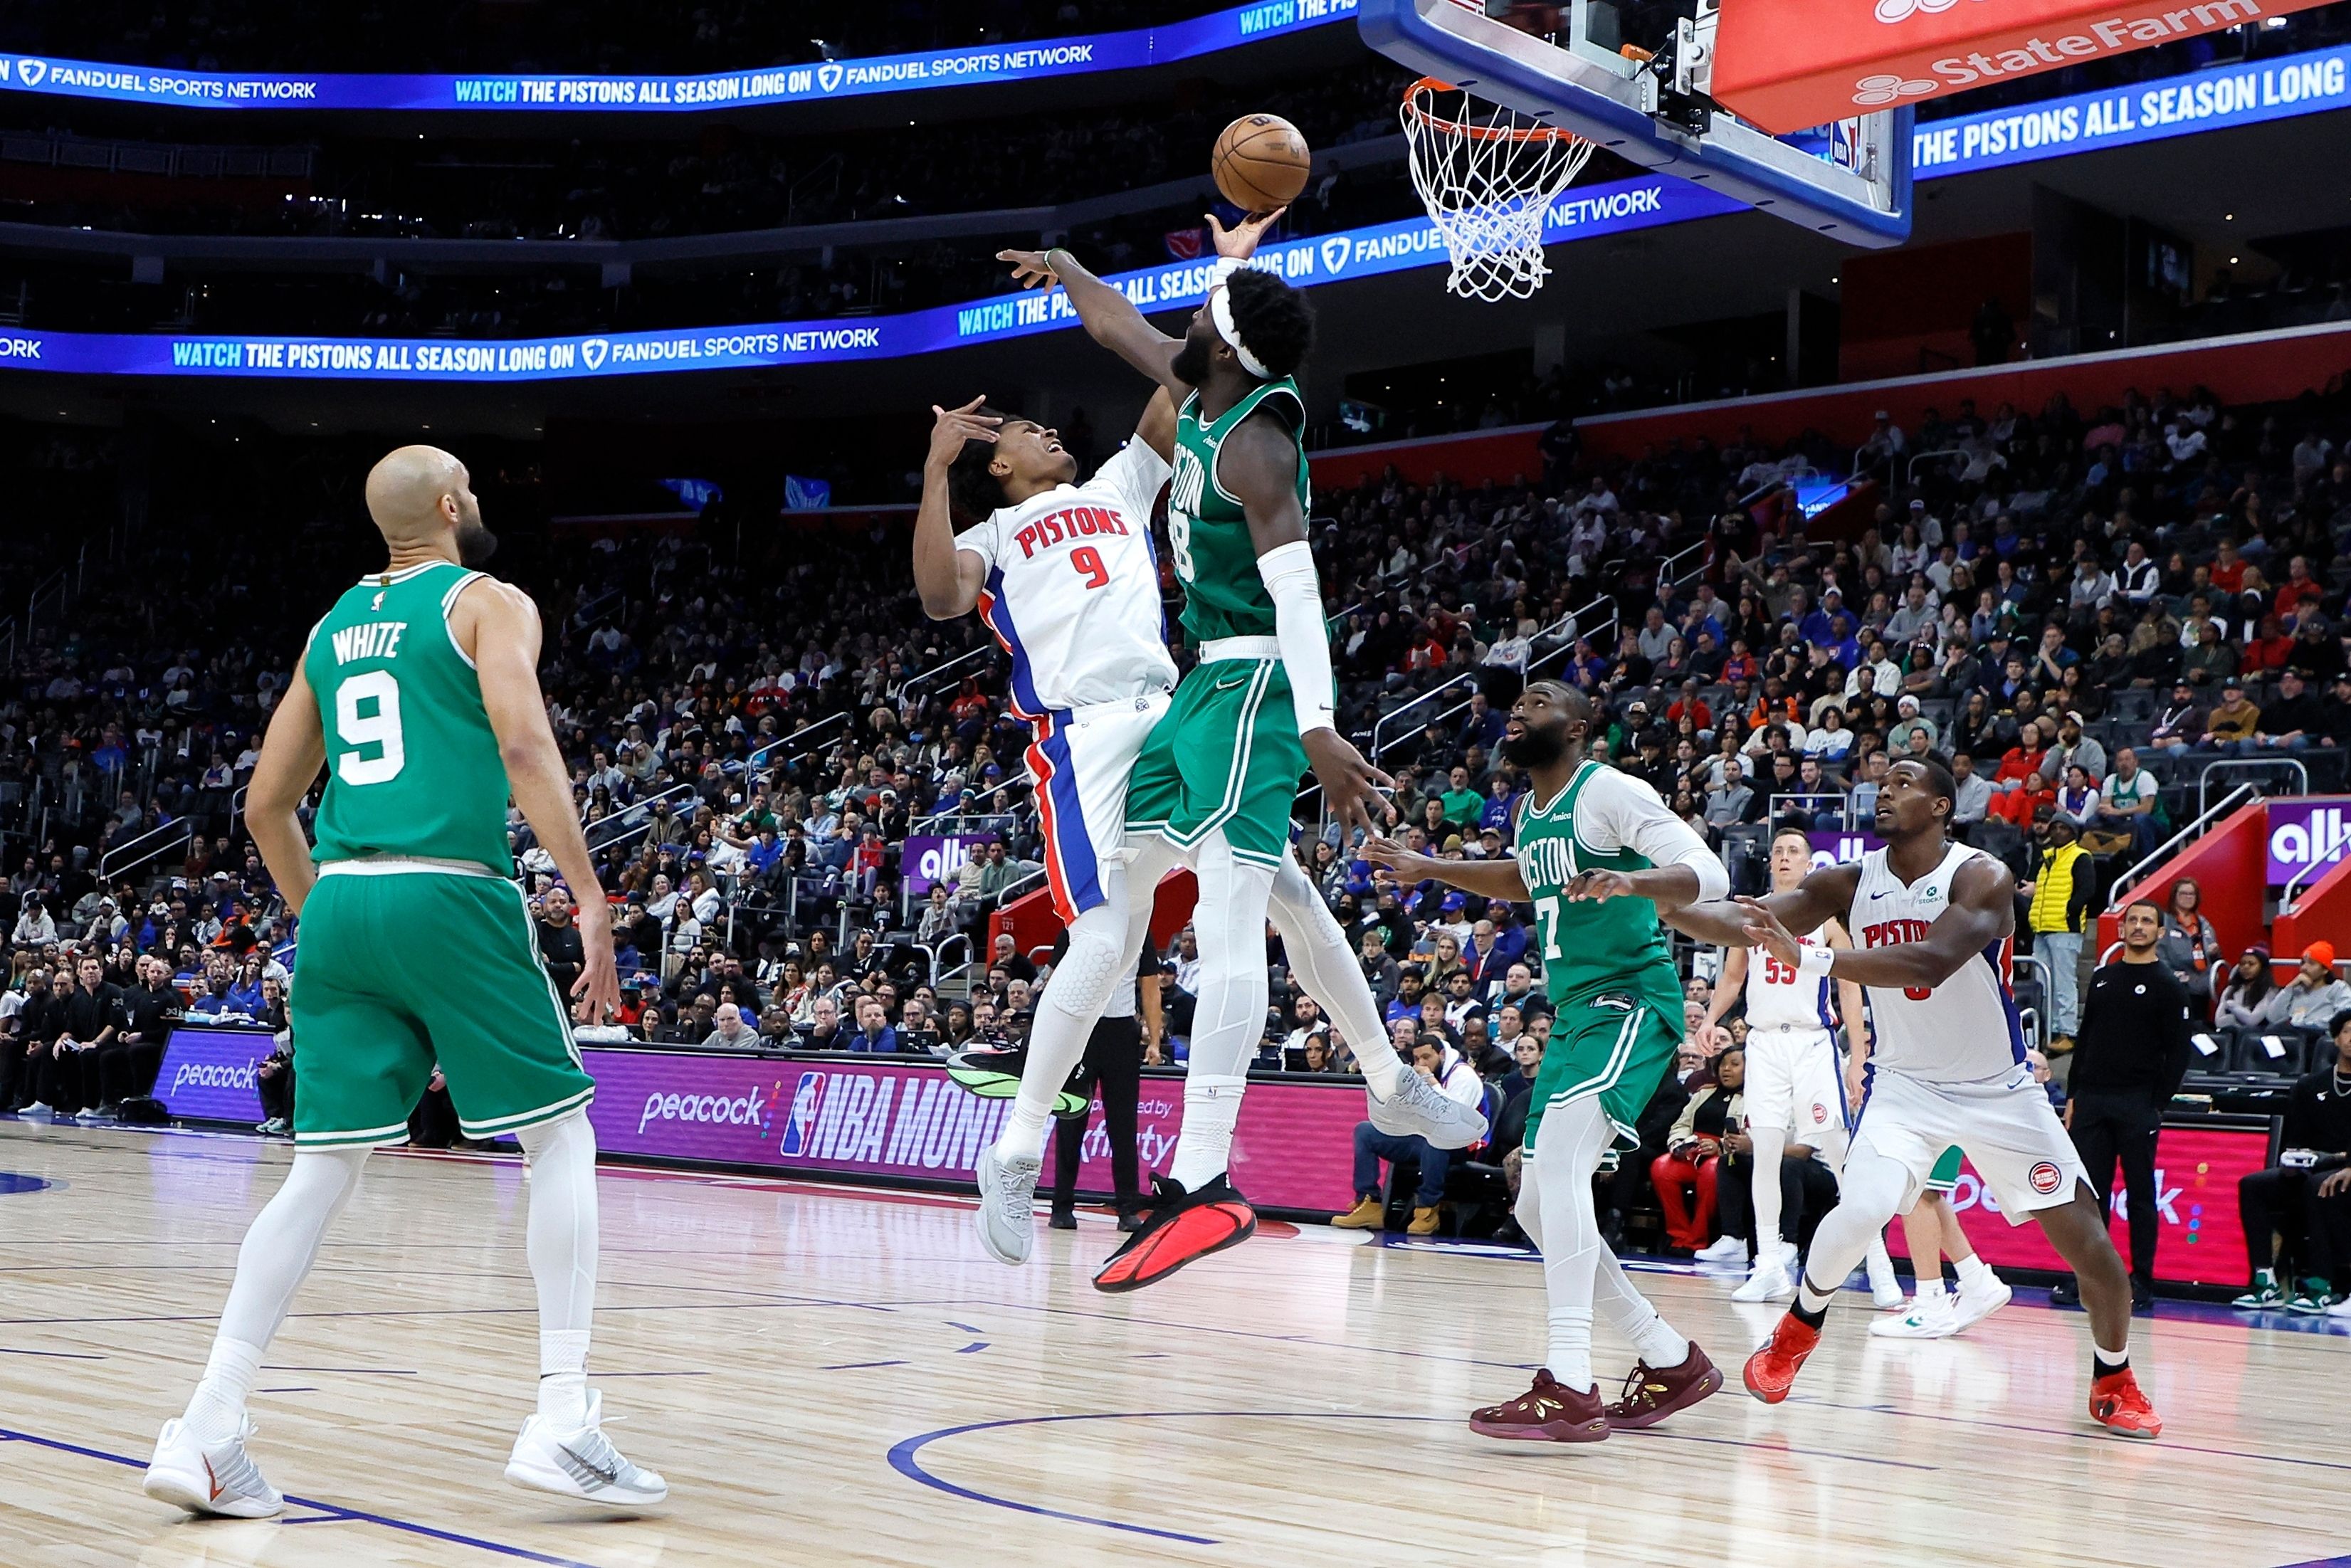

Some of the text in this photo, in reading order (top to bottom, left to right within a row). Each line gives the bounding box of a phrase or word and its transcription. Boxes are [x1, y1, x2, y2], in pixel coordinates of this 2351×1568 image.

[1240, 0, 1294, 35] WATCH
[1298, 0, 1328, 21] THE
[51, 68, 146, 93] FANDUEL
[148, 76, 223, 98] SPORTS
[227, 82, 317, 99] NETWORK
[455, 44, 1093, 104] WATCH THE PISTONS ALL SEASON LONG ON FANDUEL SPORTS NETWORK
[1912, 56, 2346, 169] THE PISTONS ALL SEASON LONG
[1834, 141, 1848, 162] NBA
[958, 302, 1014, 337] WATCH
[1016, 294, 1049, 325] THE
[1126, 270, 1157, 307] ALL
[1159, 263, 1217, 301] SEASO
[1286, 246, 1315, 278] ON
[1547, 186, 1662, 228] NETWORK
[173, 327, 880, 372] WATCH THE PISTONS ALL SEASON LONG ON FANDUEL SPORTS NETWORK
[1014, 507, 1130, 559] PISTONS
[1070, 546, 1110, 590] 9
[332, 621, 408, 666] WHITE
[336, 669, 405, 786] 9
[1550, 811, 1572, 823] Amica
[1535, 895, 1562, 960] 7
[1765, 957, 1797, 985] 55
[170, 1057, 258, 1097] peacock
[637, 1085, 766, 1135] peacock
[808, 1073, 897, 1164] NBA
[1155, 1099, 1173, 1119] by
